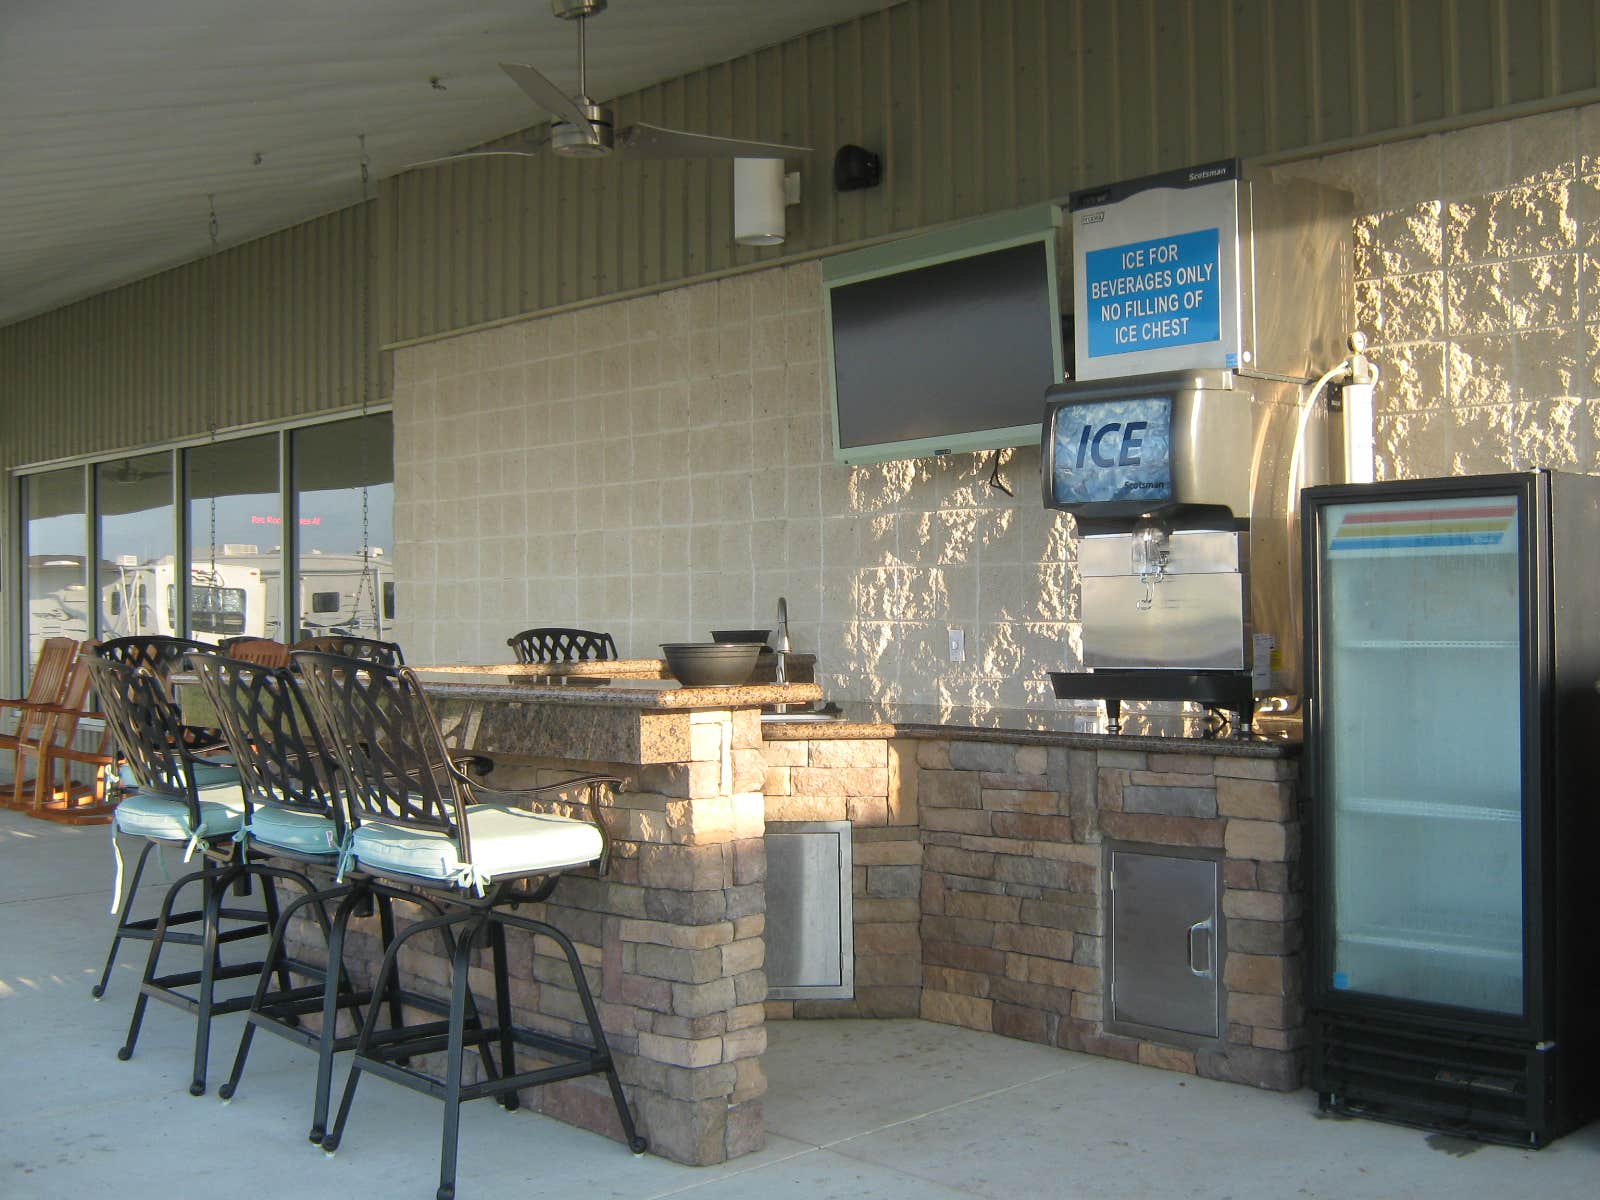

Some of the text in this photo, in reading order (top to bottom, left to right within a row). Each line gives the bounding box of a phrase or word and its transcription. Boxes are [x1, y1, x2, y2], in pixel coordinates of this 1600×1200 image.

[1188, 167, 1226, 181] Scotsman
[1122, 244, 1178, 270] ICE FOR
[1091, 263, 1213, 300] BEVERAGES ONLY
[1101, 290, 1203, 322] NO FILLING OF
[1115, 317, 1190, 344] ICE CHEST
[1075, 421, 1148, 469] ICE
[1124, 480, 1165, 490] Scotsman
